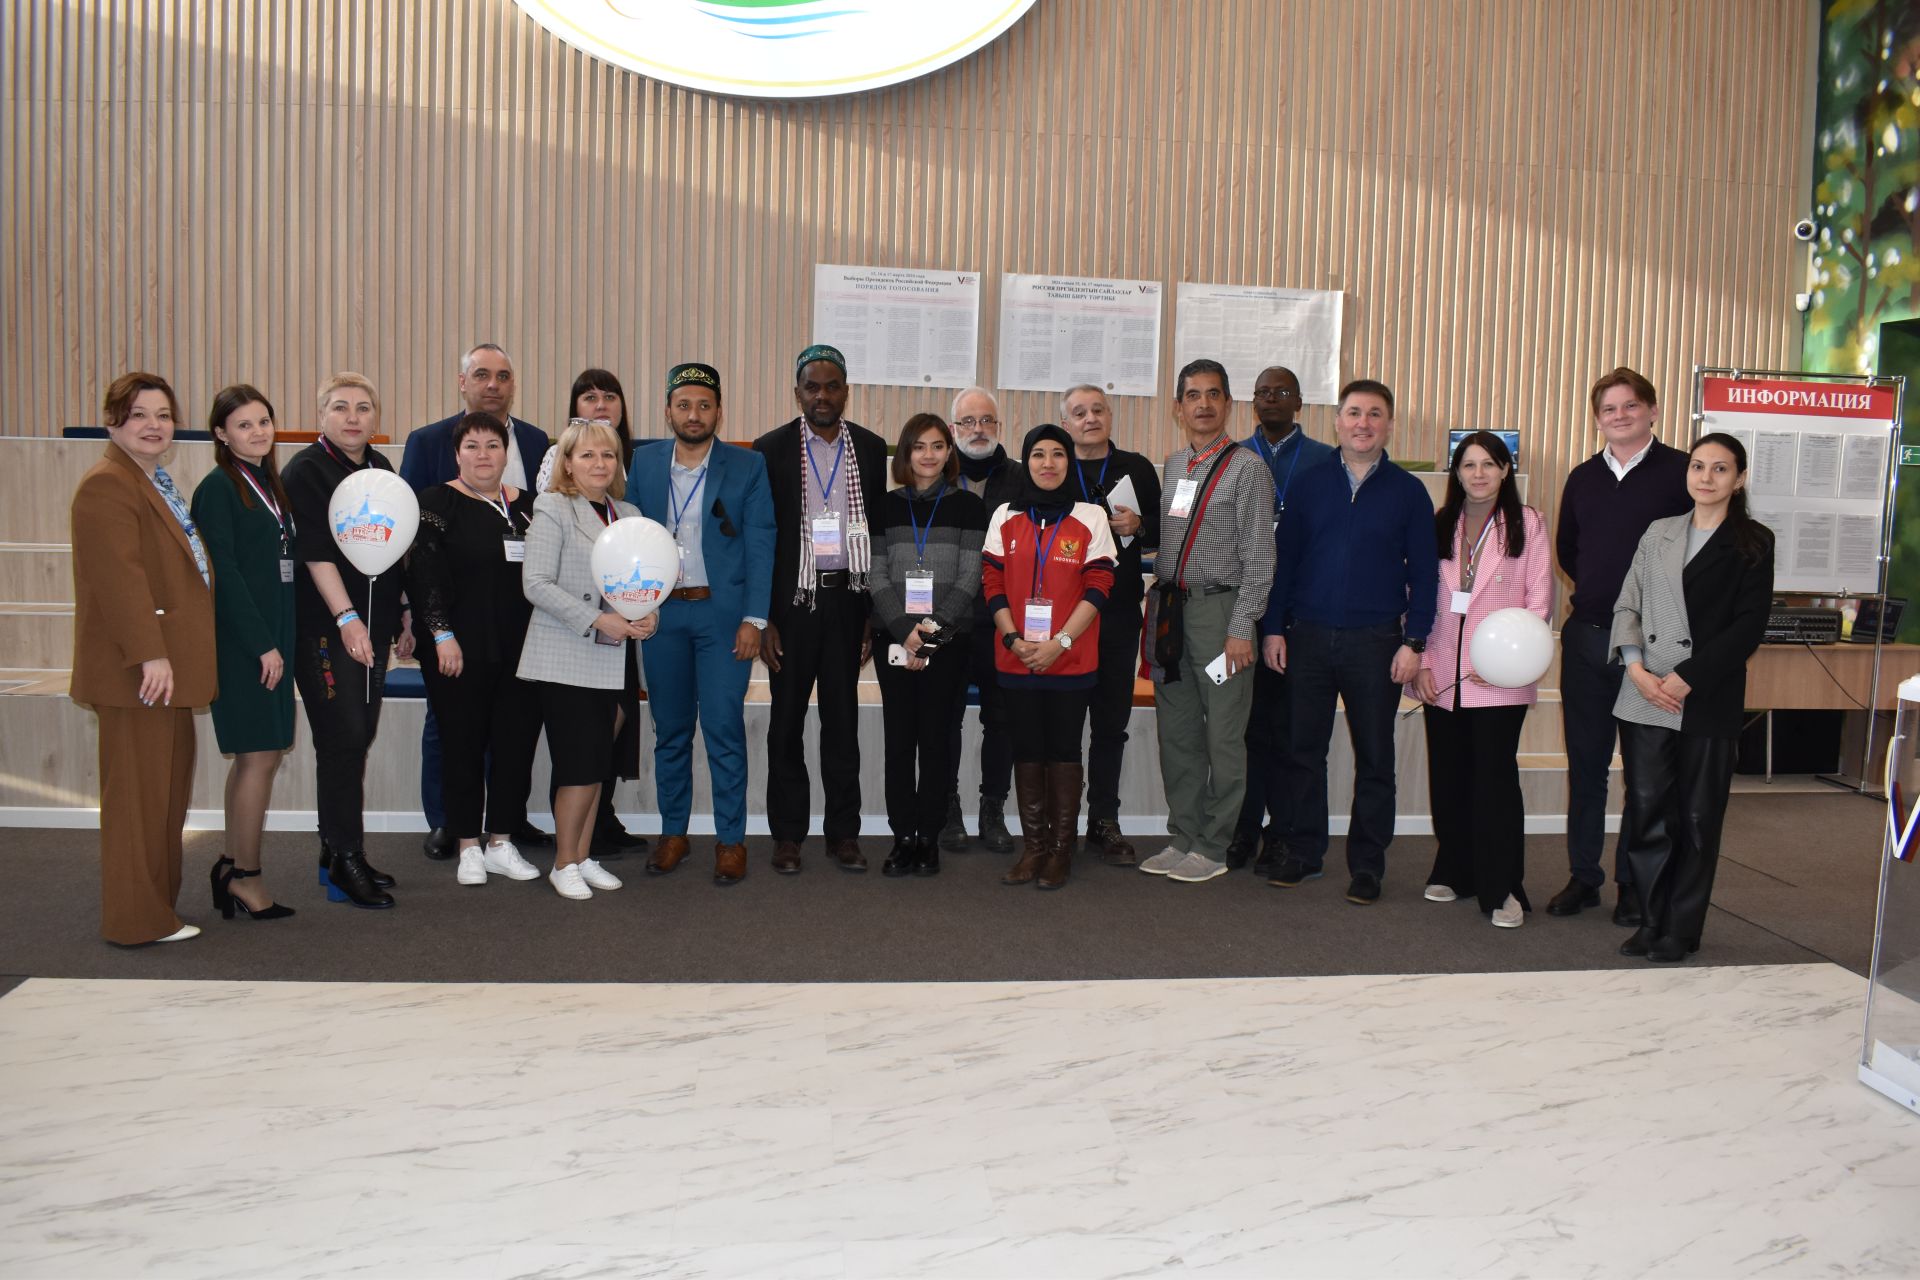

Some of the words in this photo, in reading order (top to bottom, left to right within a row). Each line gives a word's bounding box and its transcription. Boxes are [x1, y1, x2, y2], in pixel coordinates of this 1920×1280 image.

[889, 285, 939, 293] ГОЛОСОВАНИЯ
[1727, 387, 1872, 412] ИНФОРМАЦИЯ
[1053, 555, 1080, 564] INDONESIA
